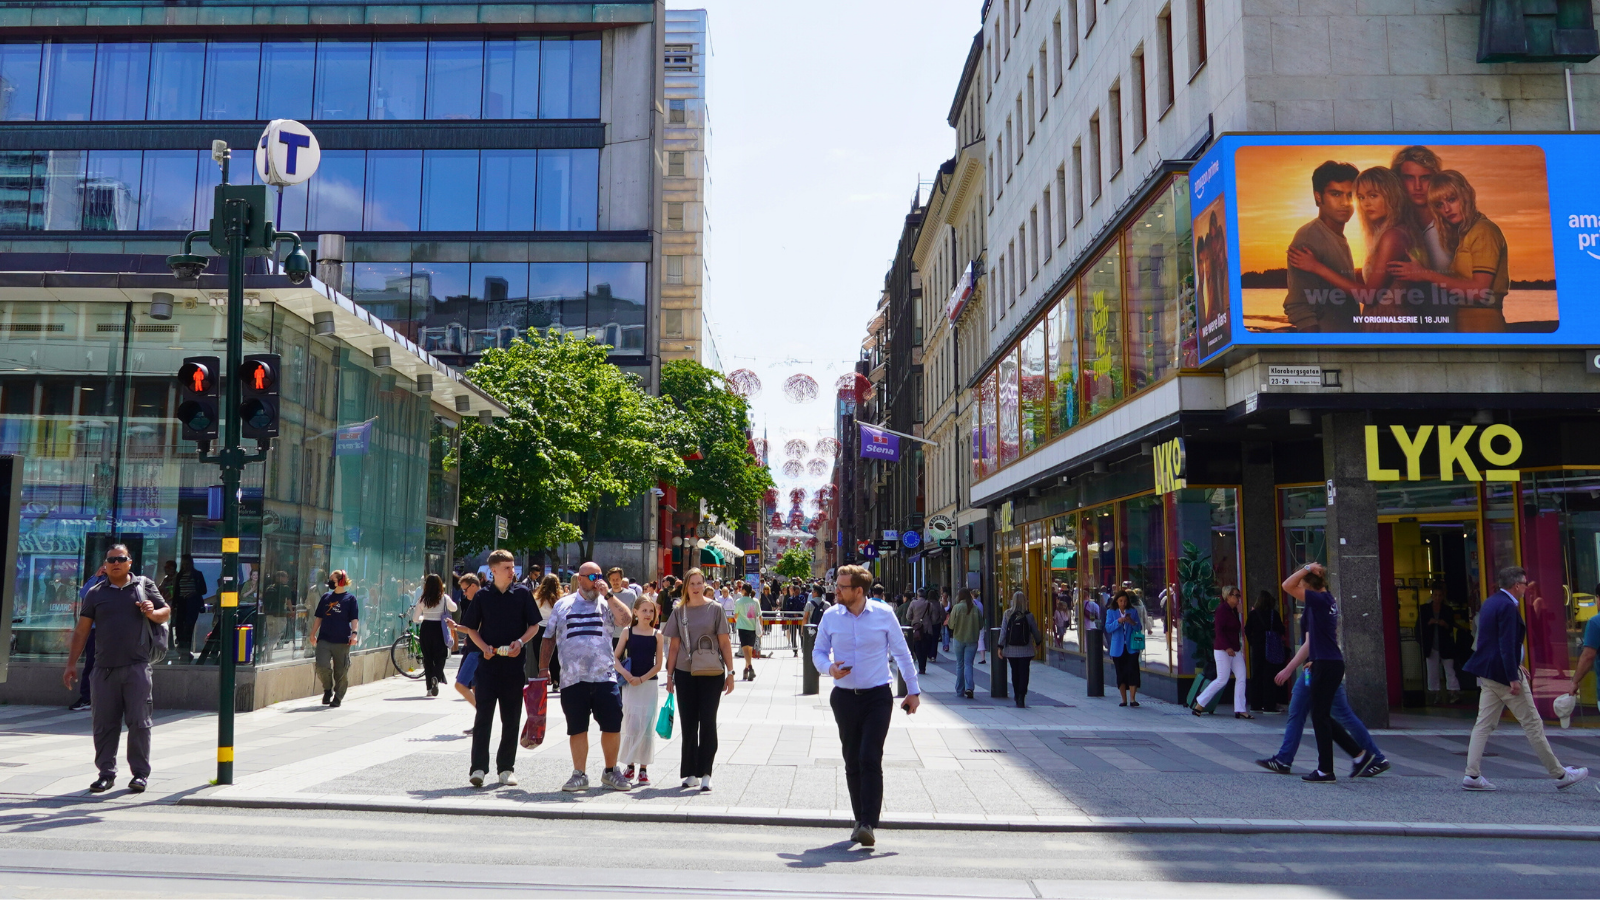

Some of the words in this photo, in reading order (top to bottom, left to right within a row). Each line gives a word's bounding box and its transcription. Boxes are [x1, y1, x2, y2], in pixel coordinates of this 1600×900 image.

[279, 130, 310, 175] T
[1569, 214, 1600, 228] am
[1578, 230, 1600, 251] pr
[1303, 287, 1347, 305] we
[1351, 287, 1425, 305] were
[1431, 282, 1496, 305] liars
[1208, 318, 1218, 334] were
[1217, 312, 1227, 328] liars
[1353, 316, 1364, 324] NY
[1364, 316, 1418, 324] ORIGINALSERIE
[1424, 316, 1433, 324] 18
[1433, 316, 1450, 324] JUNI
[1271, 367, 1319, 376] Klarabergsgatan
[866, 444, 894, 455] Stena
[1364, 423, 1523, 482] LYKO
[1153, 437, 1182, 495] LYKO
